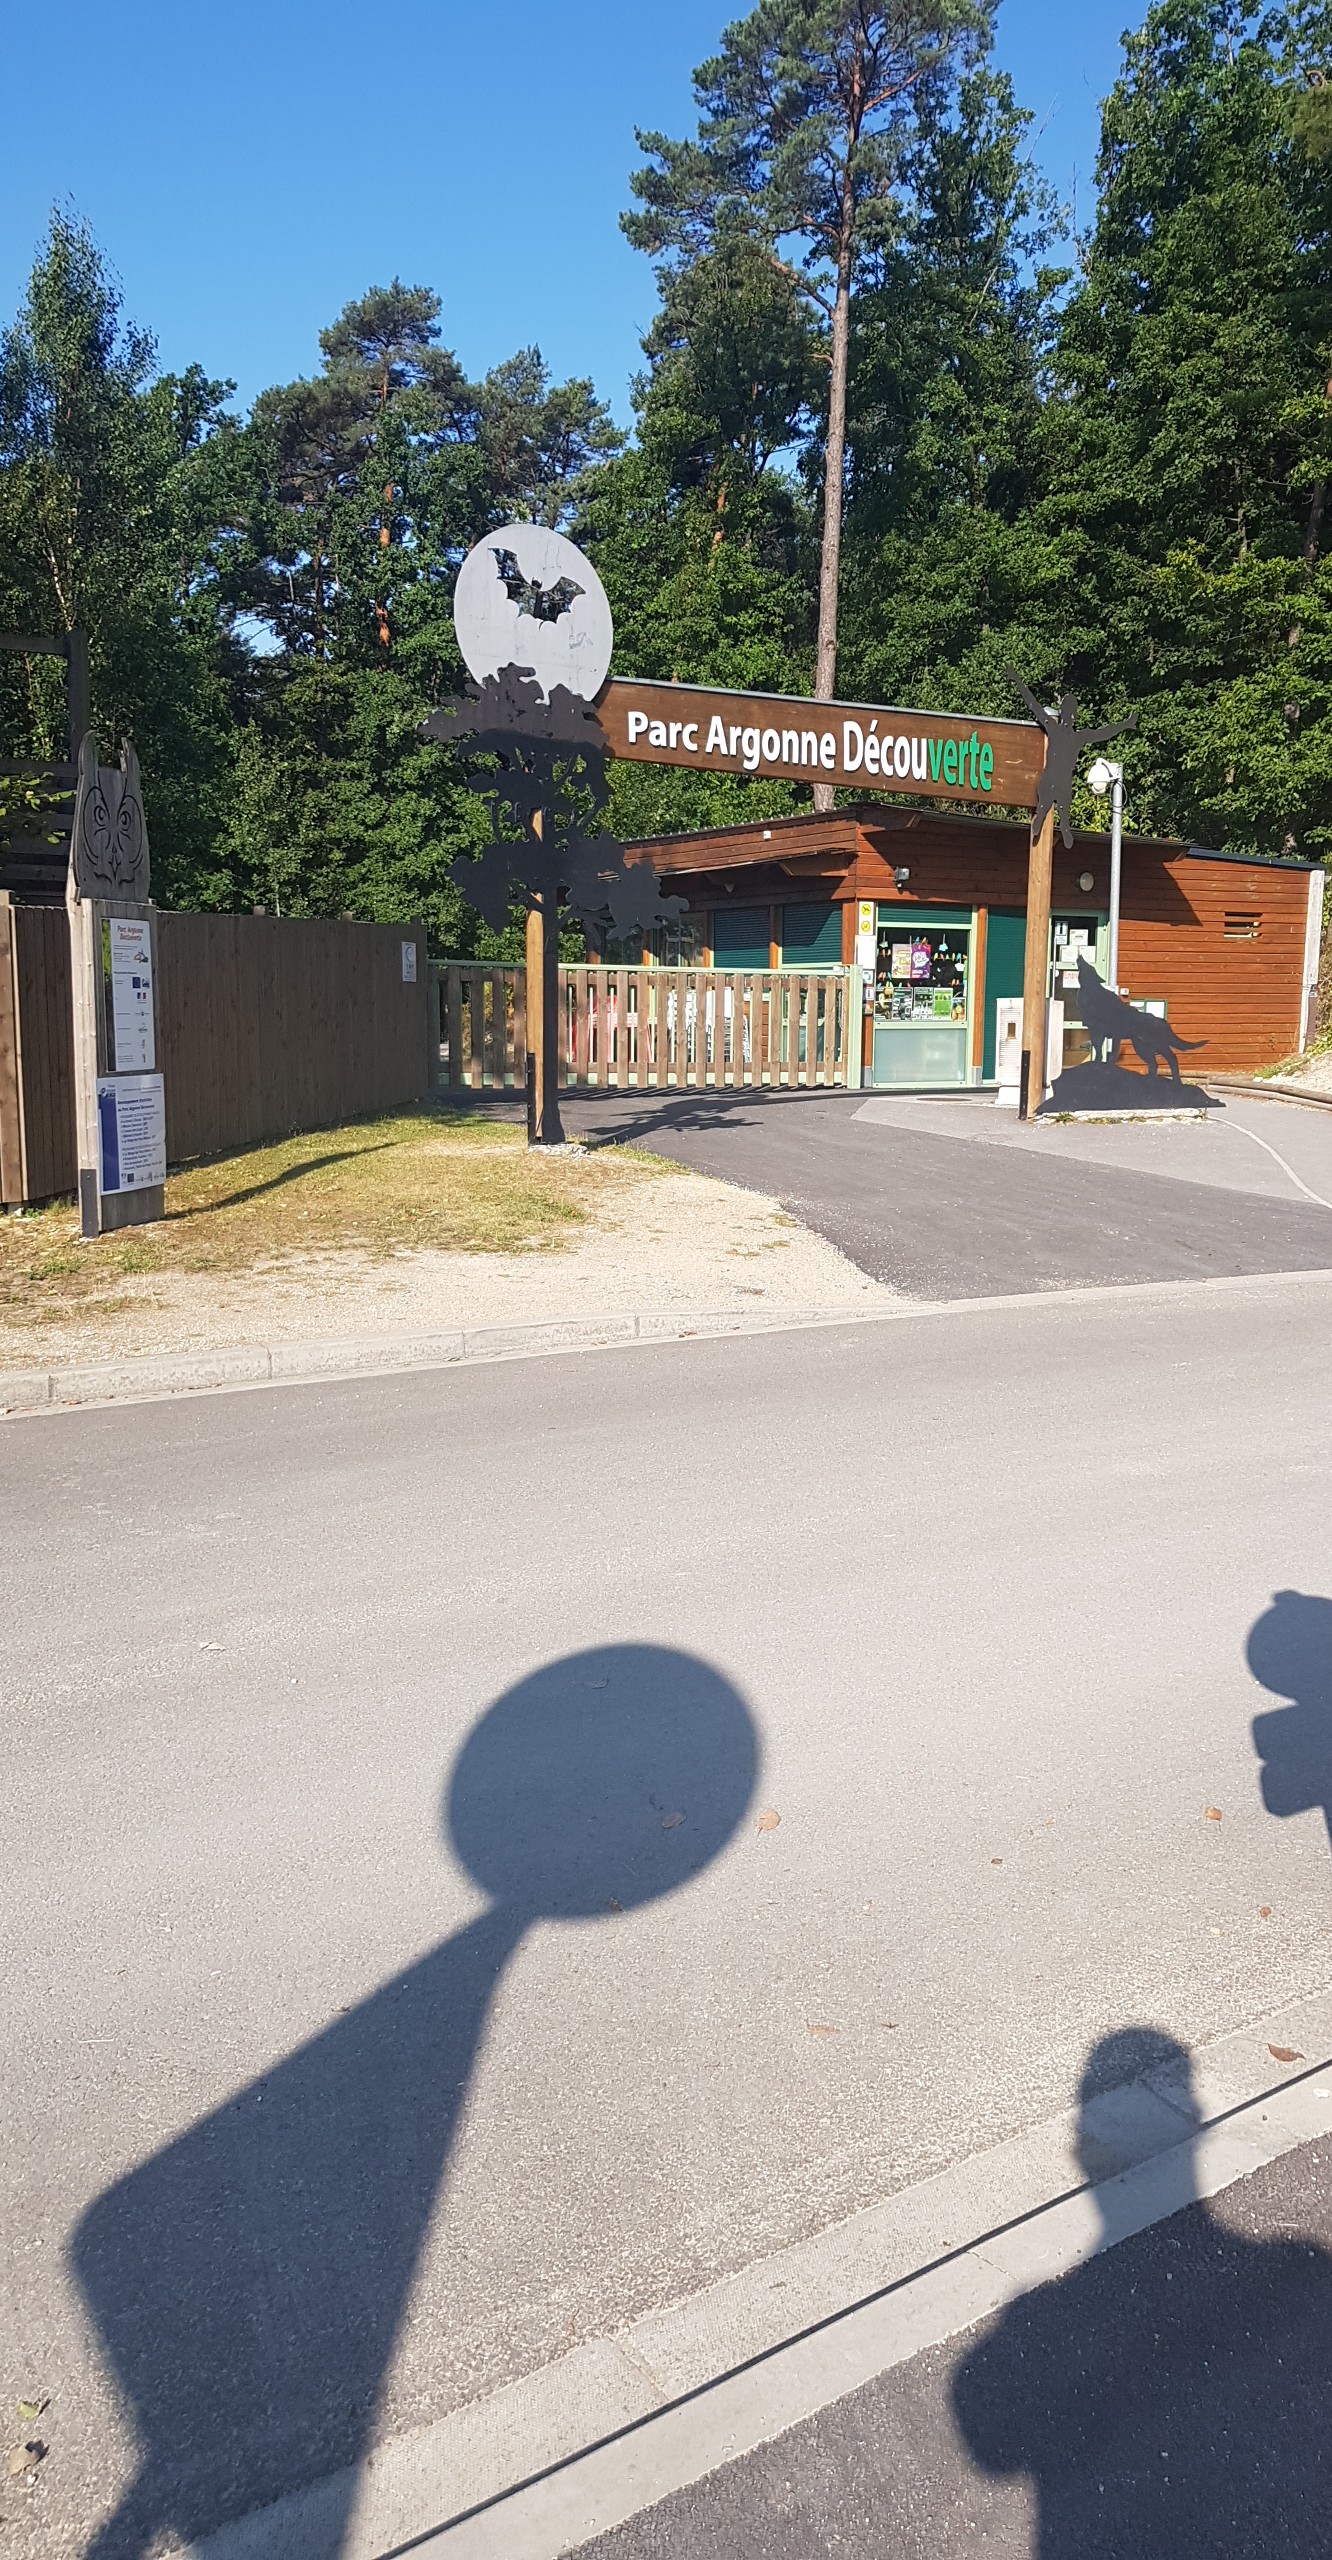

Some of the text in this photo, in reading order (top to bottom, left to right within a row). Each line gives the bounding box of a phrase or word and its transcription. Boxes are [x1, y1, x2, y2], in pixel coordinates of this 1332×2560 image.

[627, 711, 994, 791] Parc Argonne Découverte
